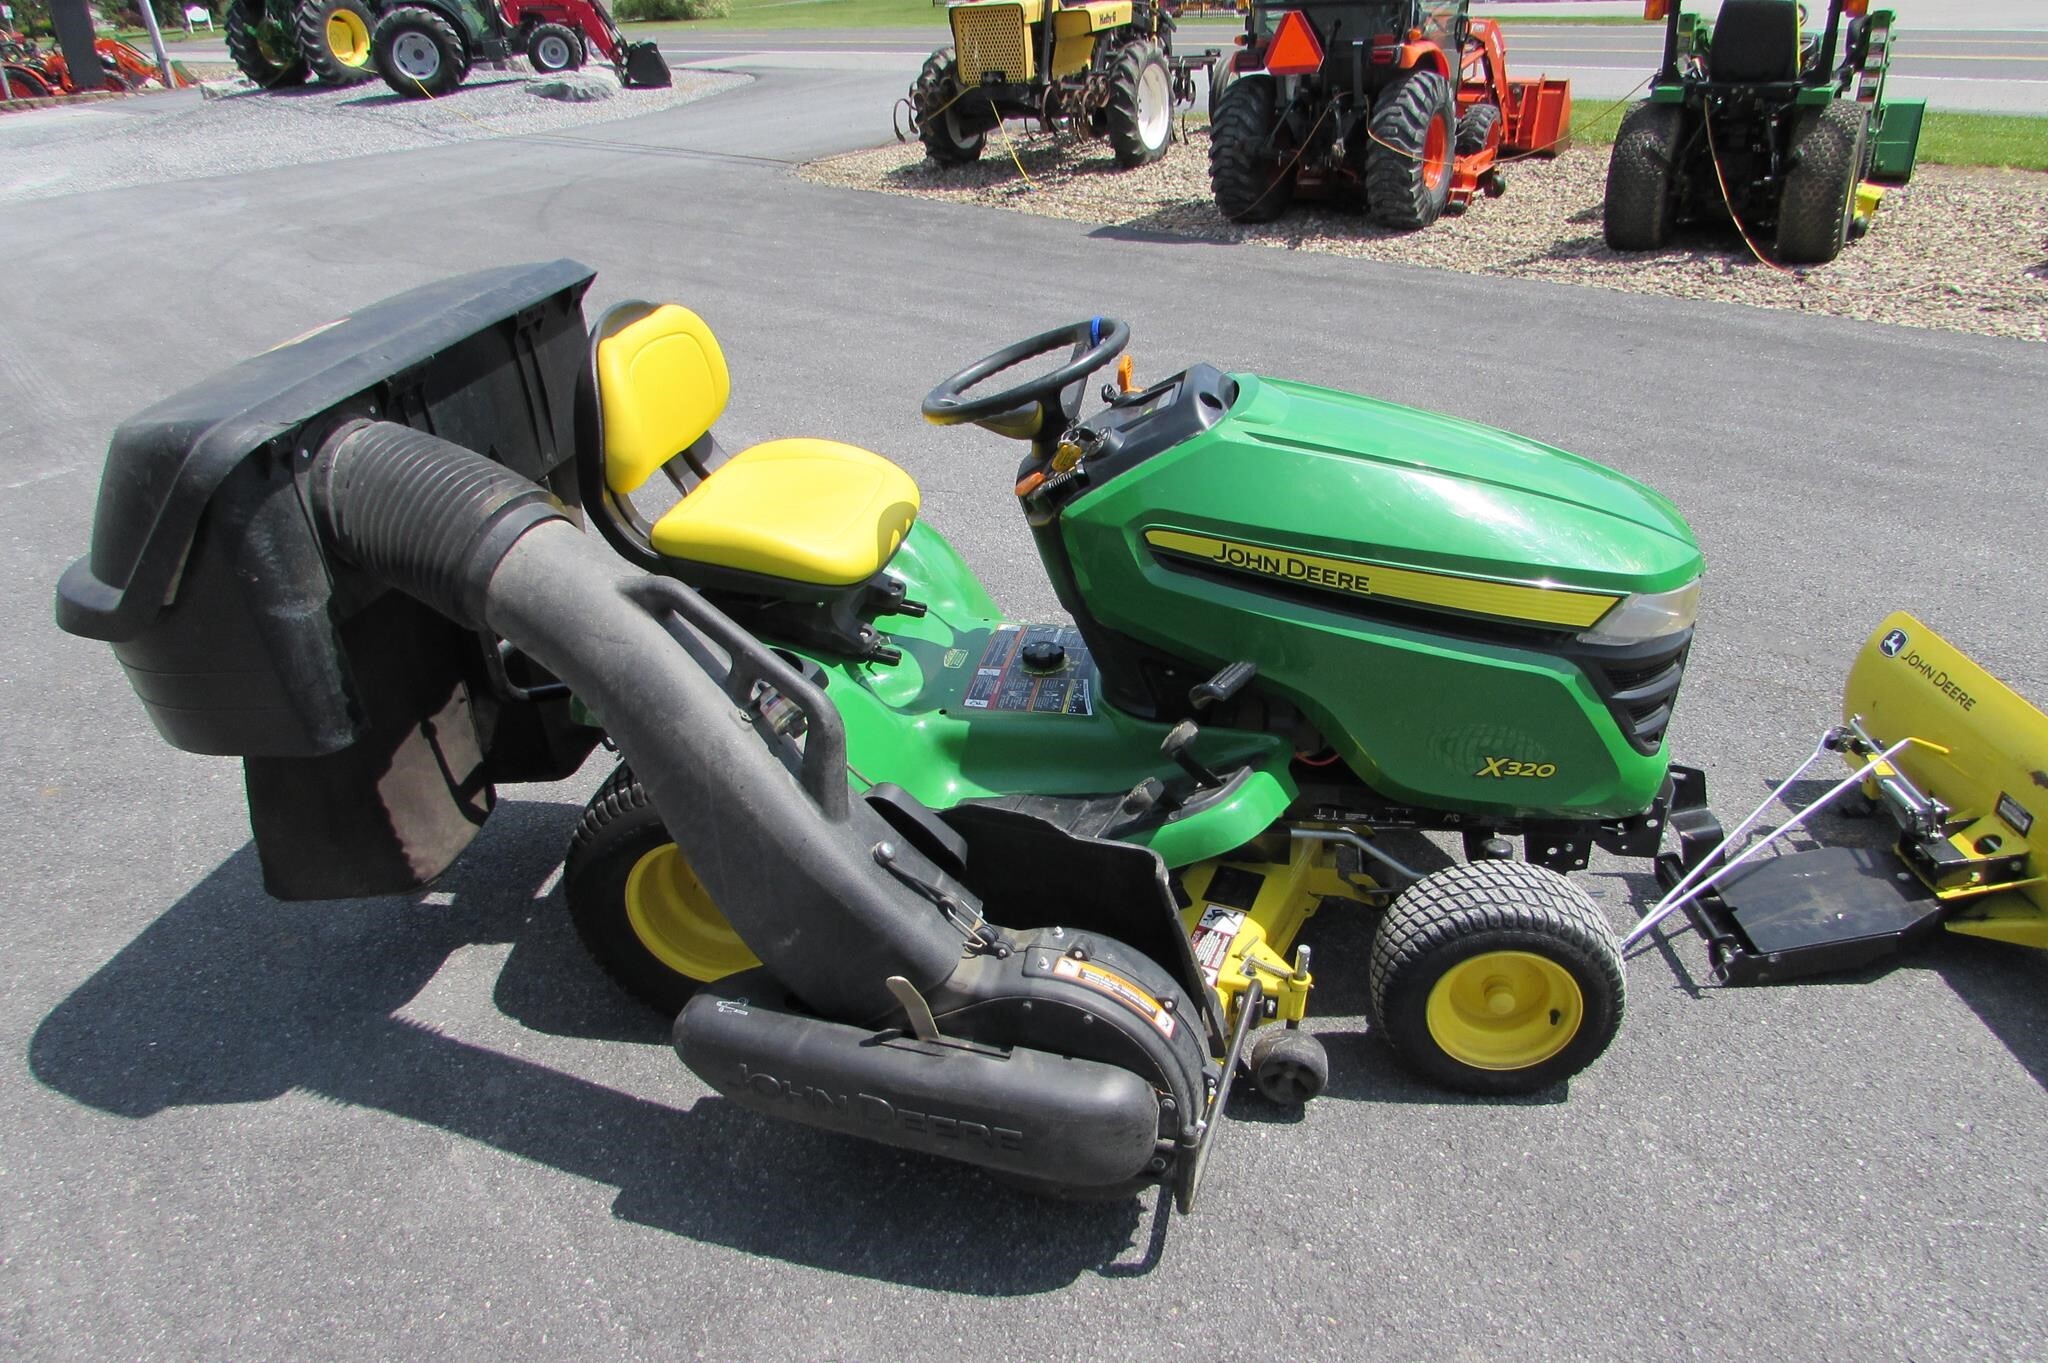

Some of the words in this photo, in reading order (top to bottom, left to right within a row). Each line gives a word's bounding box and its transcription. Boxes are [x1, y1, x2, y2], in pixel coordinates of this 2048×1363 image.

[1213, 543, 1280, 573] JOHN
[1286, 557, 1371, 592] DEERE
[1901, 649, 1936, 679] JOHN
[1932, 671, 1976, 711] DEERE
[1474, 756, 1557, 778] X320
[725, 1063, 848, 1115] JOHN
[856, 1091, 1023, 1151] DEERE
